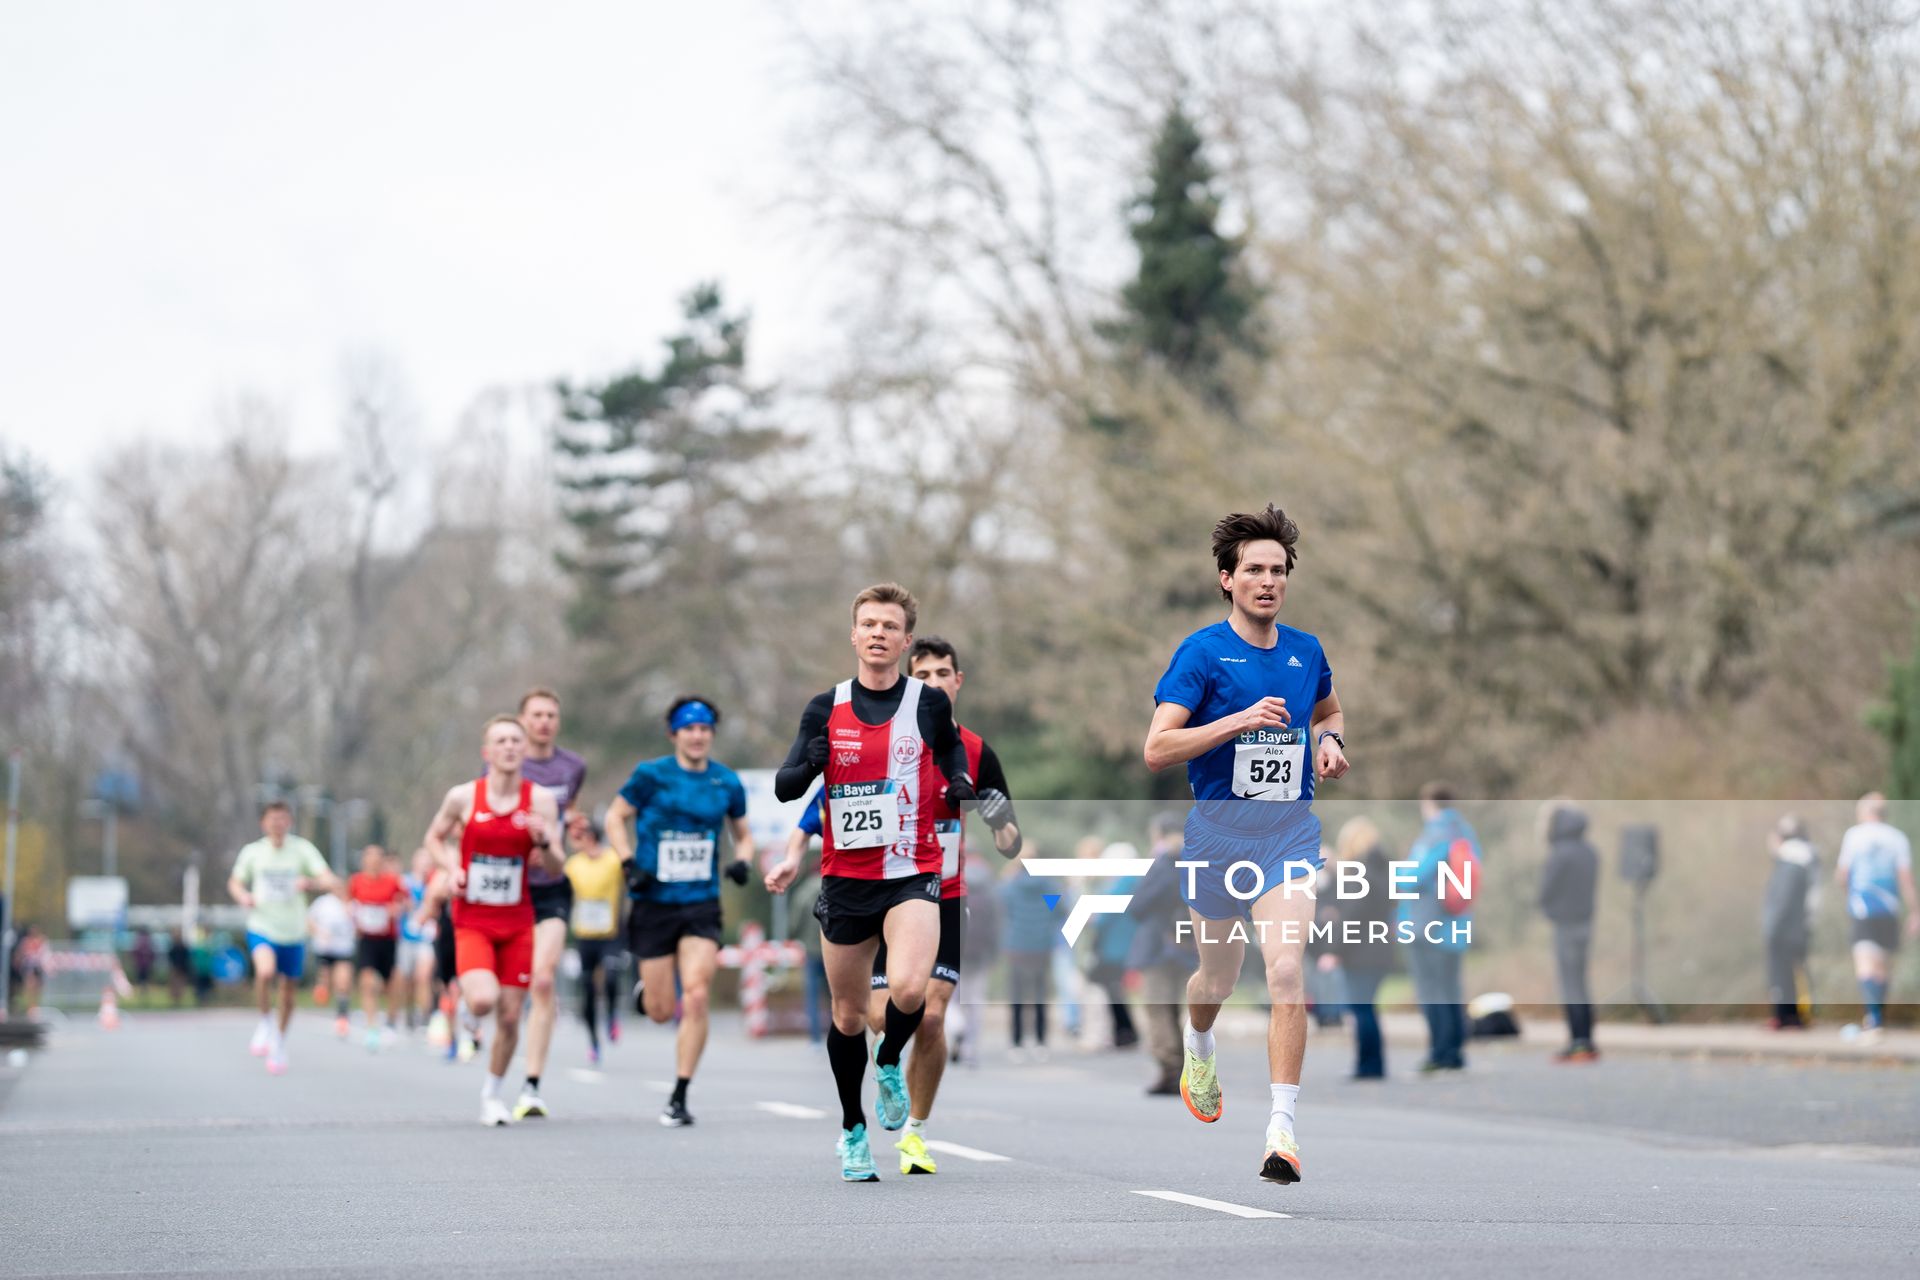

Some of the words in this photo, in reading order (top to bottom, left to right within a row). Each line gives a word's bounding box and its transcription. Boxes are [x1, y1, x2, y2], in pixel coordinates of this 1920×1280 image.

[1258, 730, 1292, 744] Bayer
[1265, 747, 1284, 755] Alex
[1250, 759, 1292, 783] 523
[843, 784, 877, 797] Bayer
[848, 799, 873, 807] Lothar
[842, 809, 883, 832] 225
